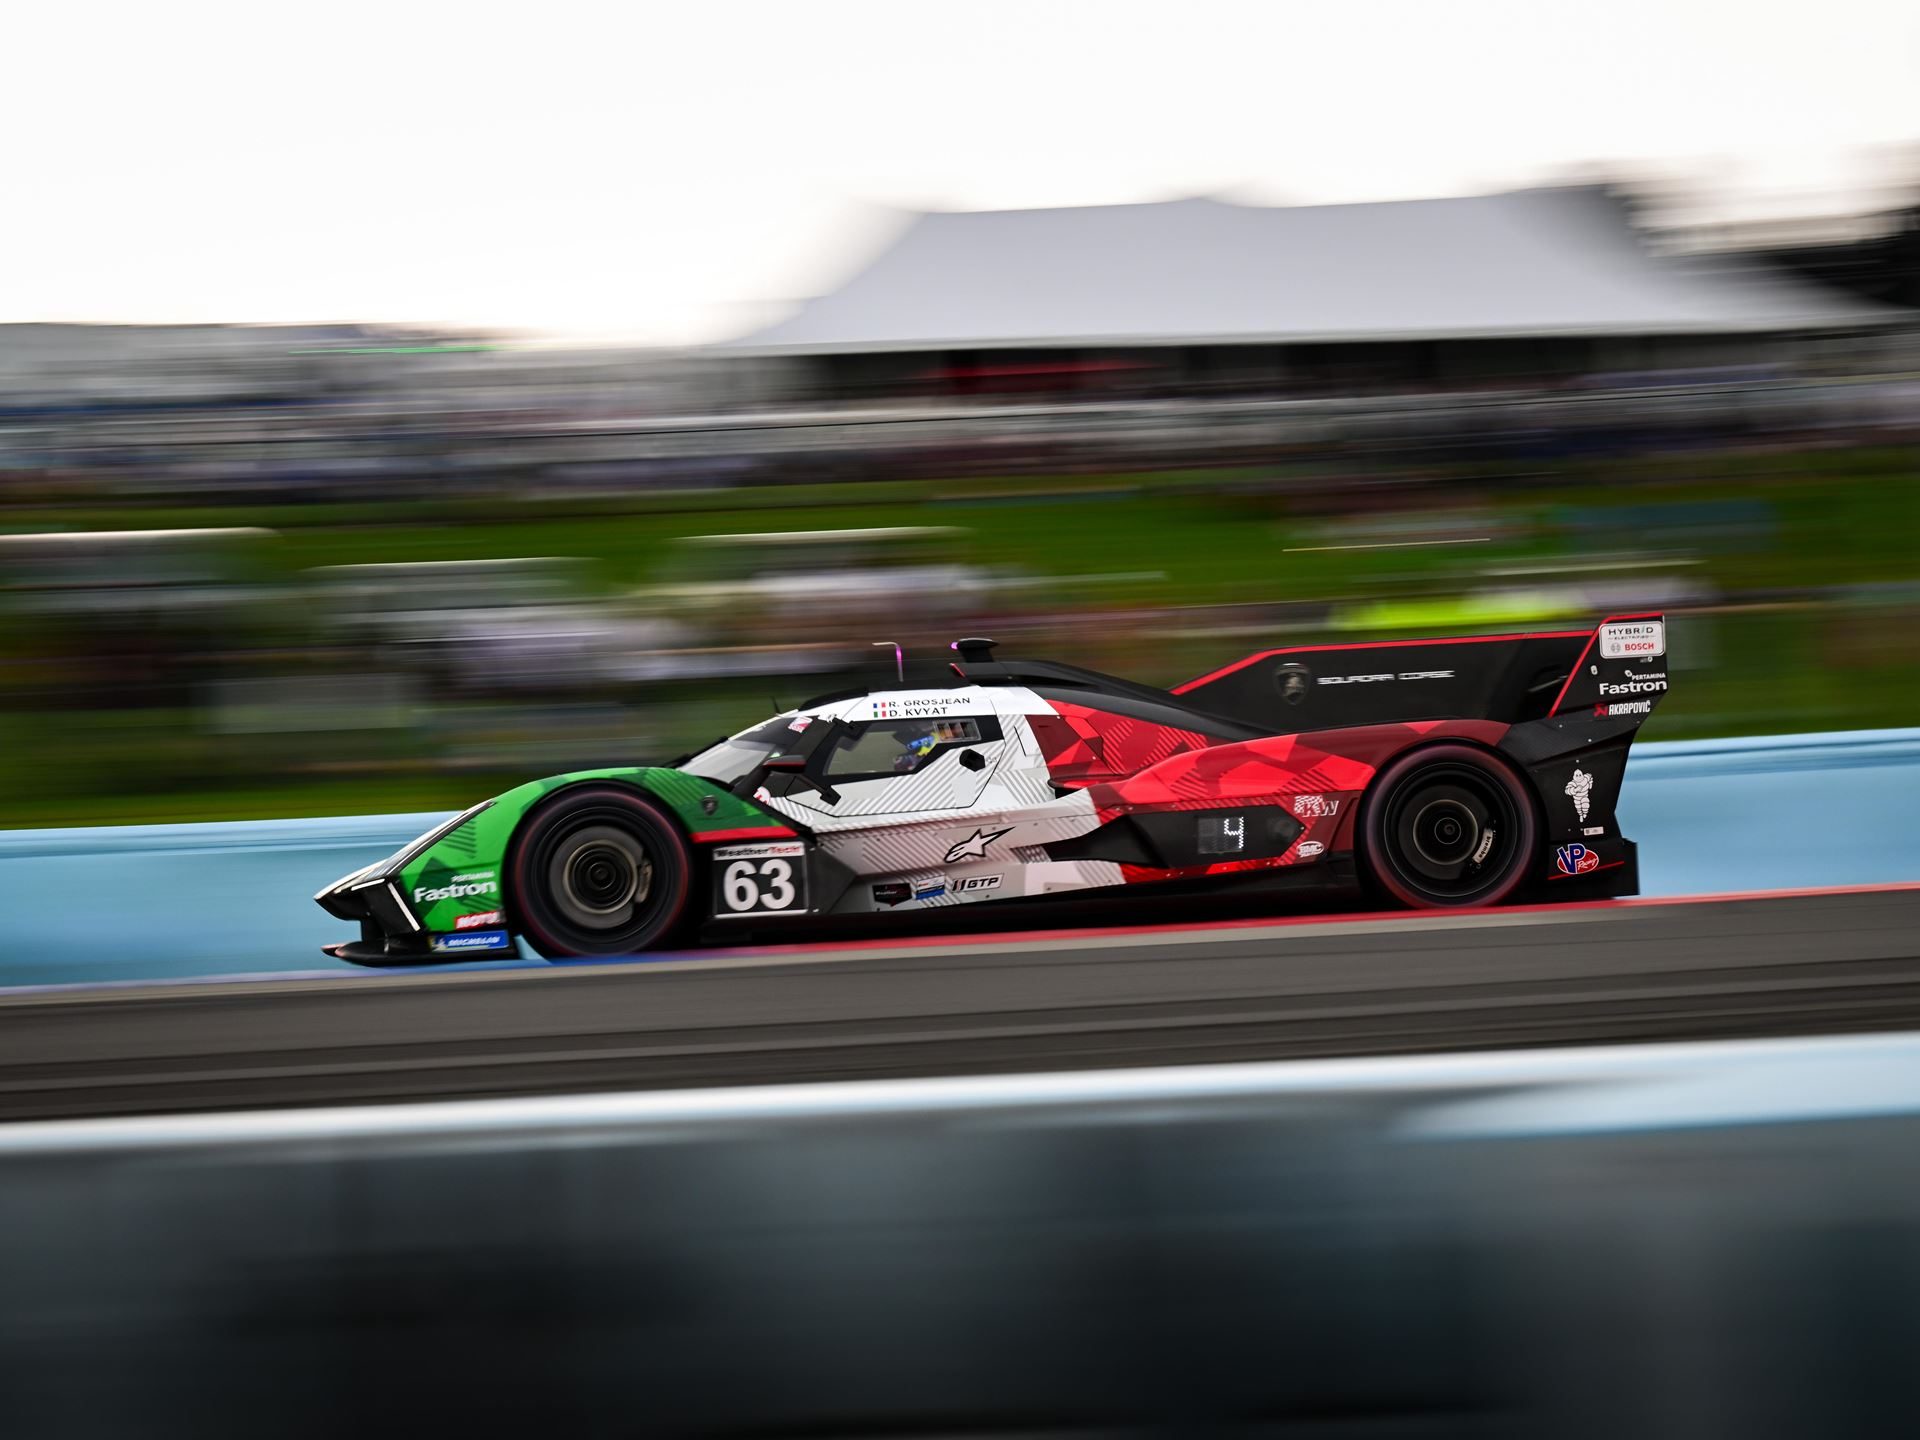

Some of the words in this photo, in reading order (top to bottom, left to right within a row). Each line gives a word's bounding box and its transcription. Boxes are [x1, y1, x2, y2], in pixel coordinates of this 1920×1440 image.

[1608, 626, 1654, 636] HYBRID
[1624, 643, 1655, 651] BOSCH
[1631, 672, 1666, 681] PERTAMINA
[1599, 680, 1668, 696] Fastron
[888, 700, 900, 708] R.
[903, 697, 971, 707] GROSJEAN
[889, 709, 902, 717] D.
[905, 707, 948, 716] KVYAT
[1224, 816, 1244, 849] 4
[1557, 843, 1586, 874] VP
[723, 858, 796, 911] 63
[967, 877, 999, 889] GTP
[414, 881, 497, 903] Fastron
